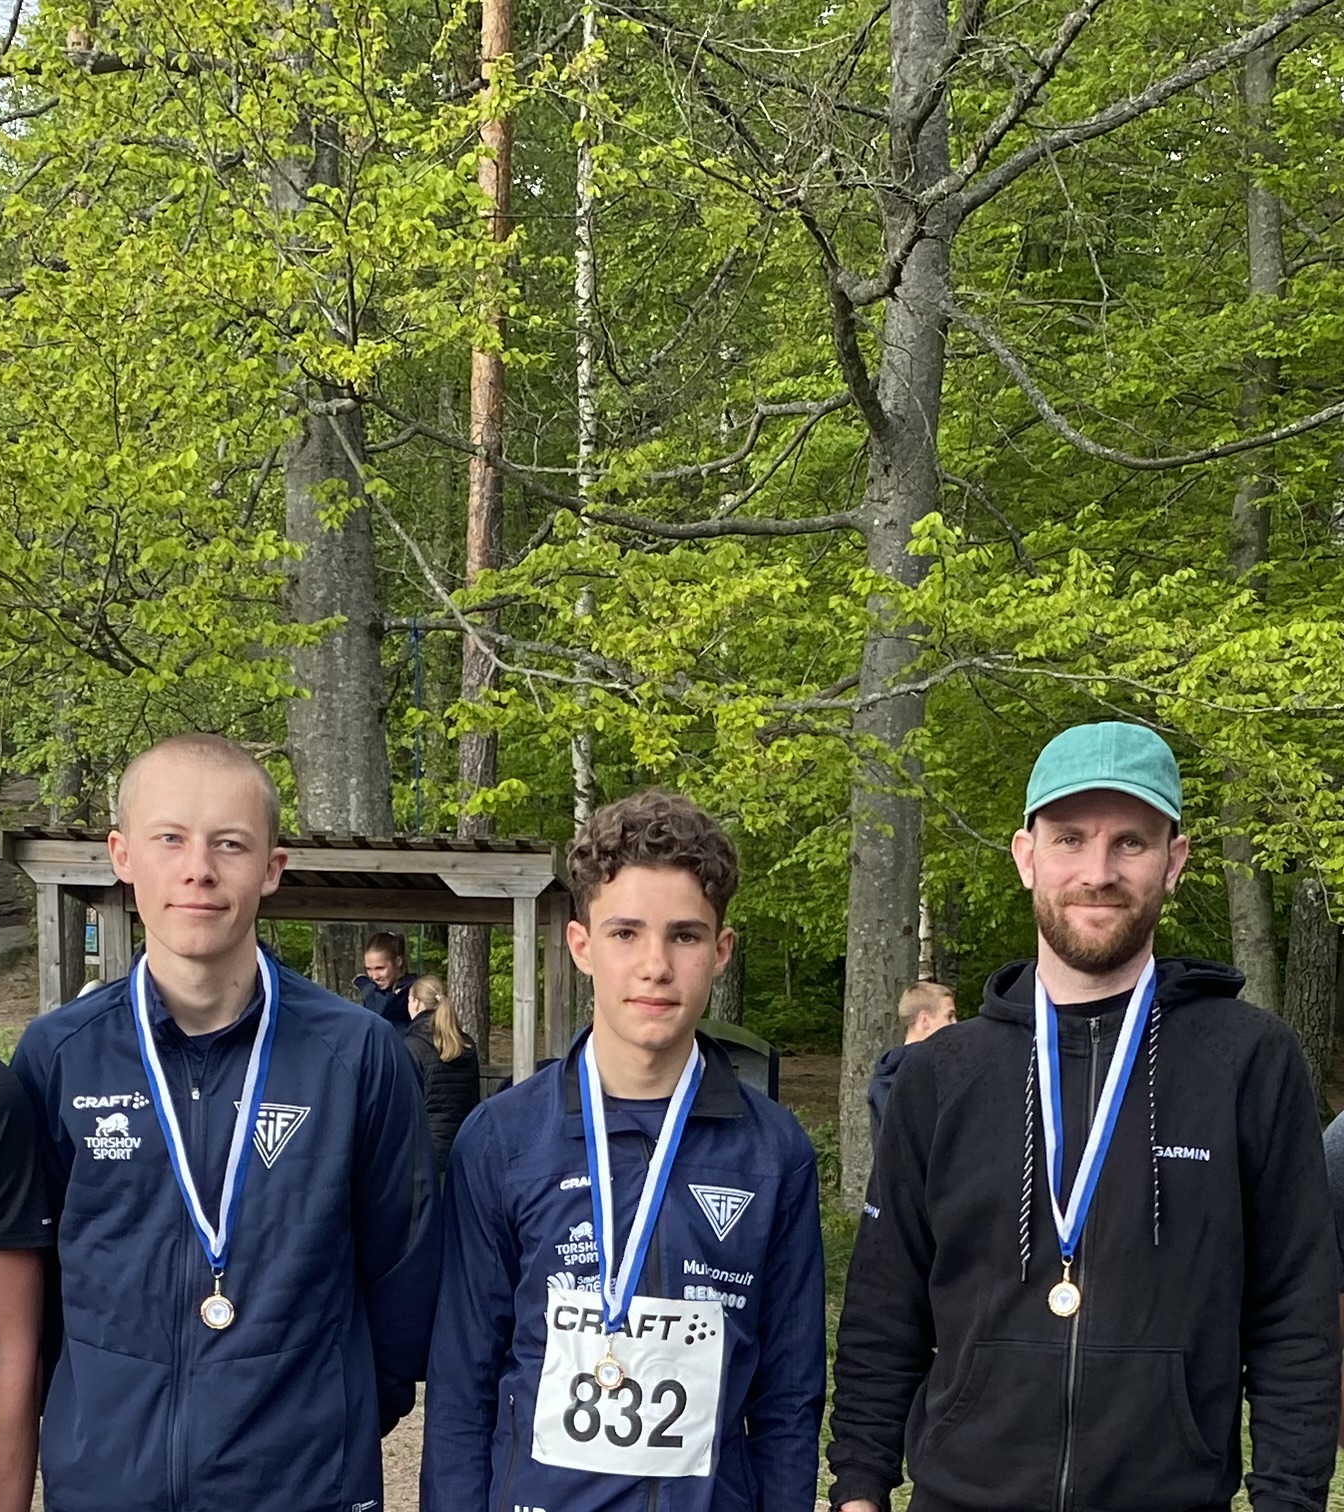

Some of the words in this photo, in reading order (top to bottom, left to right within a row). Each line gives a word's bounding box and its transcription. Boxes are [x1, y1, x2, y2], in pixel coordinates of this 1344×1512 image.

[72, 1094, 133, 1109] CRAFT
[83, 1136, 142, 1149] TORSHOV
[93, 1148, 133, 1160] SPORT
[1154, 1145, 1211, 1161] GARMIN
[559, 1176, 592, 1190] CRA
[555, 1241, 599, 1255] TORSH
[562, 1372, 688, 1448] 832
